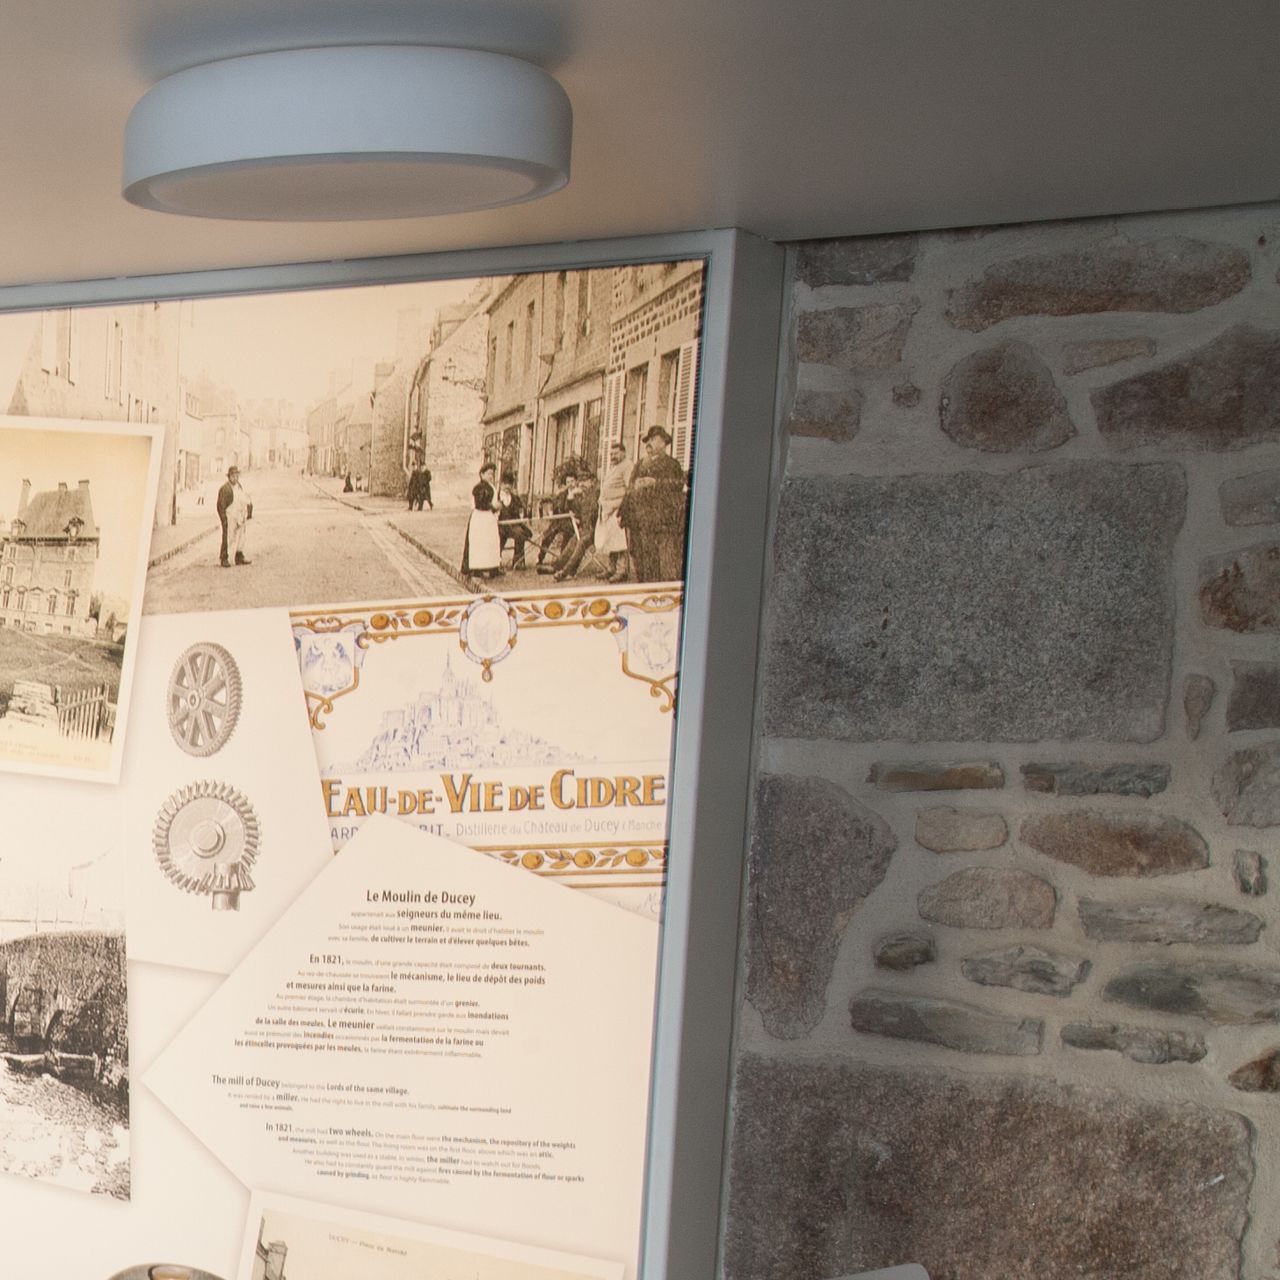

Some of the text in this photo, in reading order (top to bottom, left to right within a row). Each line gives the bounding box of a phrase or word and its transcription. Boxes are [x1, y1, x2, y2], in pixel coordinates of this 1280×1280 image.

[509, 786, 545, 810] DE
[550, 769, 666, 809] CIDRE
[456, 821, 507, 836] Distillerie
[585, 818, 619, 835] Ducey
[366, 889, 476, 908] Le Moulin de Ducey
[396, 908, 503, 922] seigneurs du même lieu.
[370, 934, 379, 943] de
[379, 934, 406, 944] cultiver
[406, 935, 414, 944] le
[413, 935, 438, 945] terrain
[438, 936, 447, 945] et
[446, 936, 475, 946] d'élever
[474, 937, 508, 949] quelques
[309, 953, 321, 964] En
[490, 961, 508, 971] deux
[286, 980, 294, 989] et
[294, 982, 326, 991] mesures
[326, 982, 345, 991] ainsi
[346, 984, 361, 994] que
[361, 983, 370, 992] la
[390, 969, 398, 980] le
[446, 972, 455, 982] le
[455, 972, 471, 983] lieu
[471, 973, 483, 983] de
[483, 973, 507, 986] dépôt
[508, 974, 523, 985] des
[523, 975, 546, 988] poids
[327, 1018, 337, 1029] Le
[338, 1018, 375, 1030] meunier
[211, 1074, 227, 1085] The
[227, 1075, 244, 1086] mill
[244, 1076, 254, 1087] of
[255, 1076, 281, 1090] Ducey
